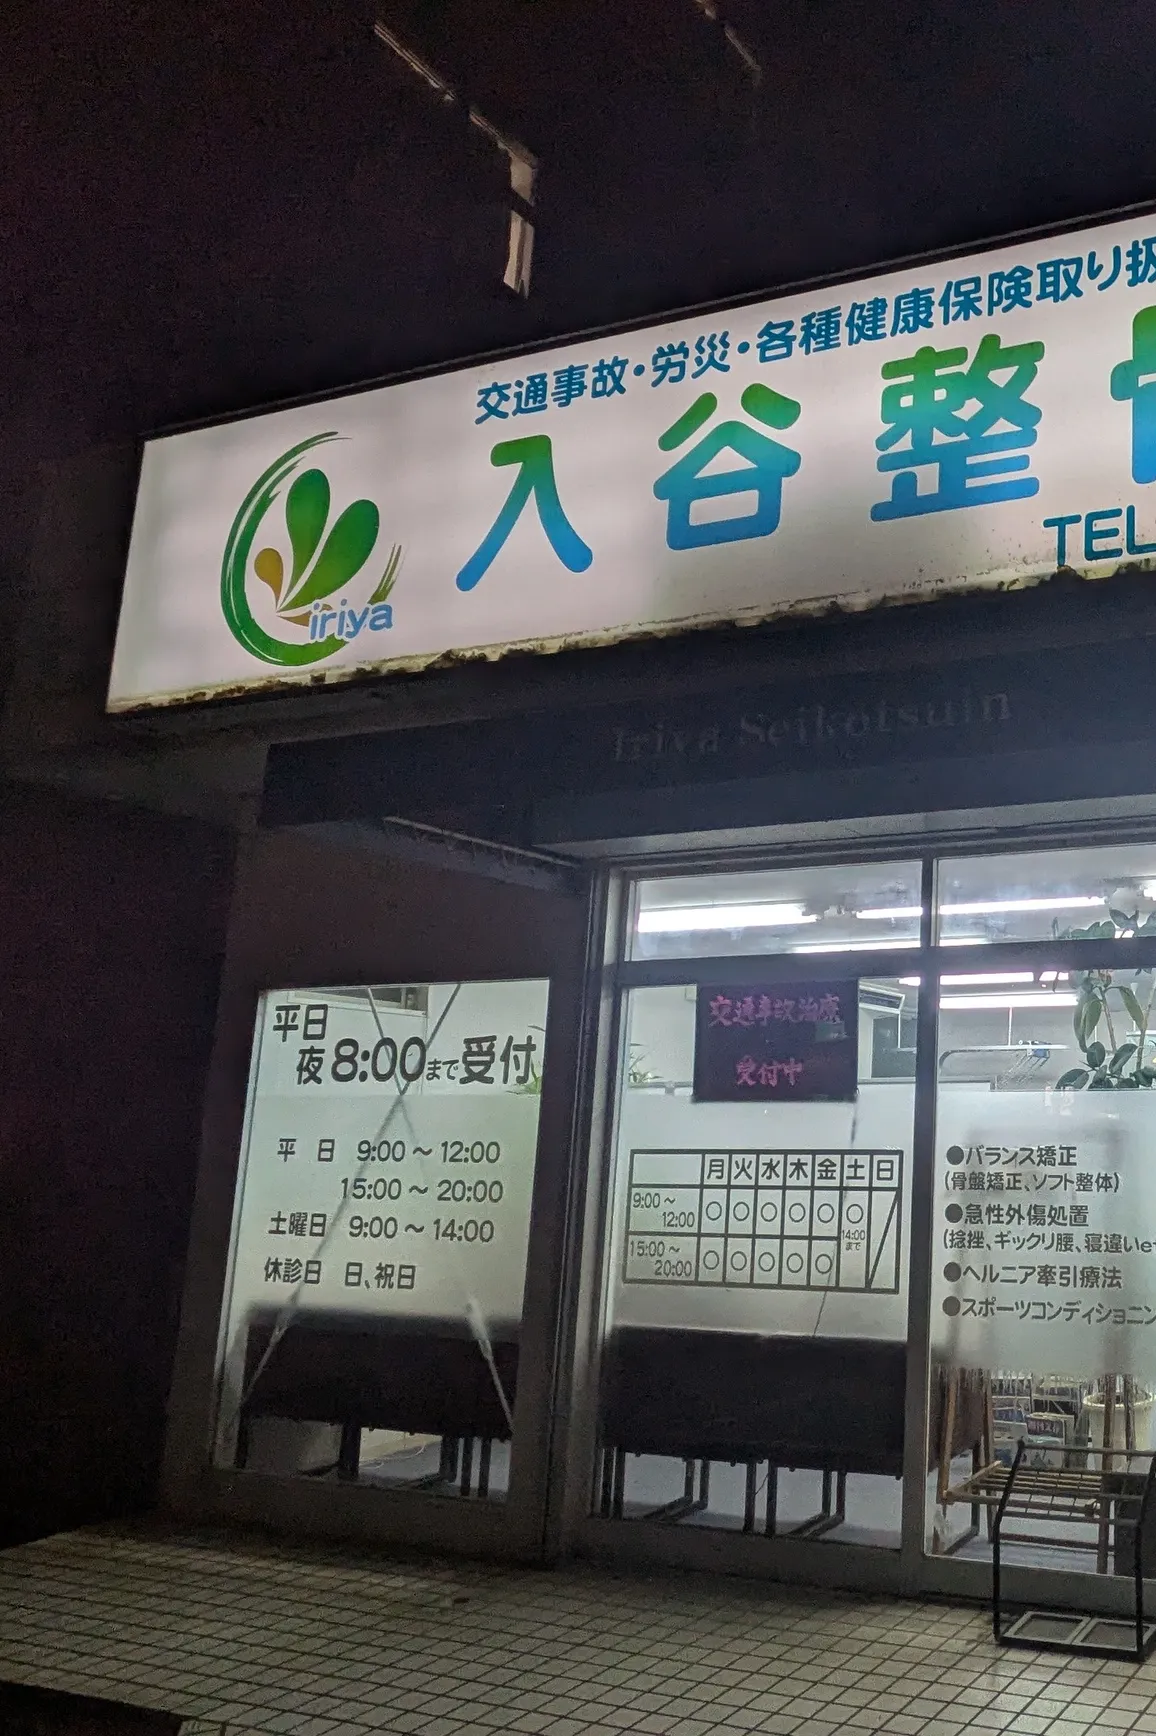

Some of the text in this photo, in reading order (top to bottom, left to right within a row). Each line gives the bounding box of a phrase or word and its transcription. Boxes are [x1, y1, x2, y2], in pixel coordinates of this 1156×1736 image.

[310, 599, 393, 640] iriya
[273, 1004, 329, 1042] 平日
[296, 1035, 537, 1085] 夜8:00まで受付
[735, 1055, 803, 1087] 受付中
[707, 1158, 894, 1181] 月 火 水 木 金 土 日
[268, 1211, 327, 1238] 土曜日
[662, 1211, 695, 1228] 12:00
[964, 1204, 1089, 1227] 急性外傷処置
[842, 1229, 866, 1241] 14:00
[264, 1257, 417, 1290] 休診日 日、祝日
[654, 1260, 692, 1277] 20:00
[962, 1264, 1122, 1289] ヘルニア牽引療法
